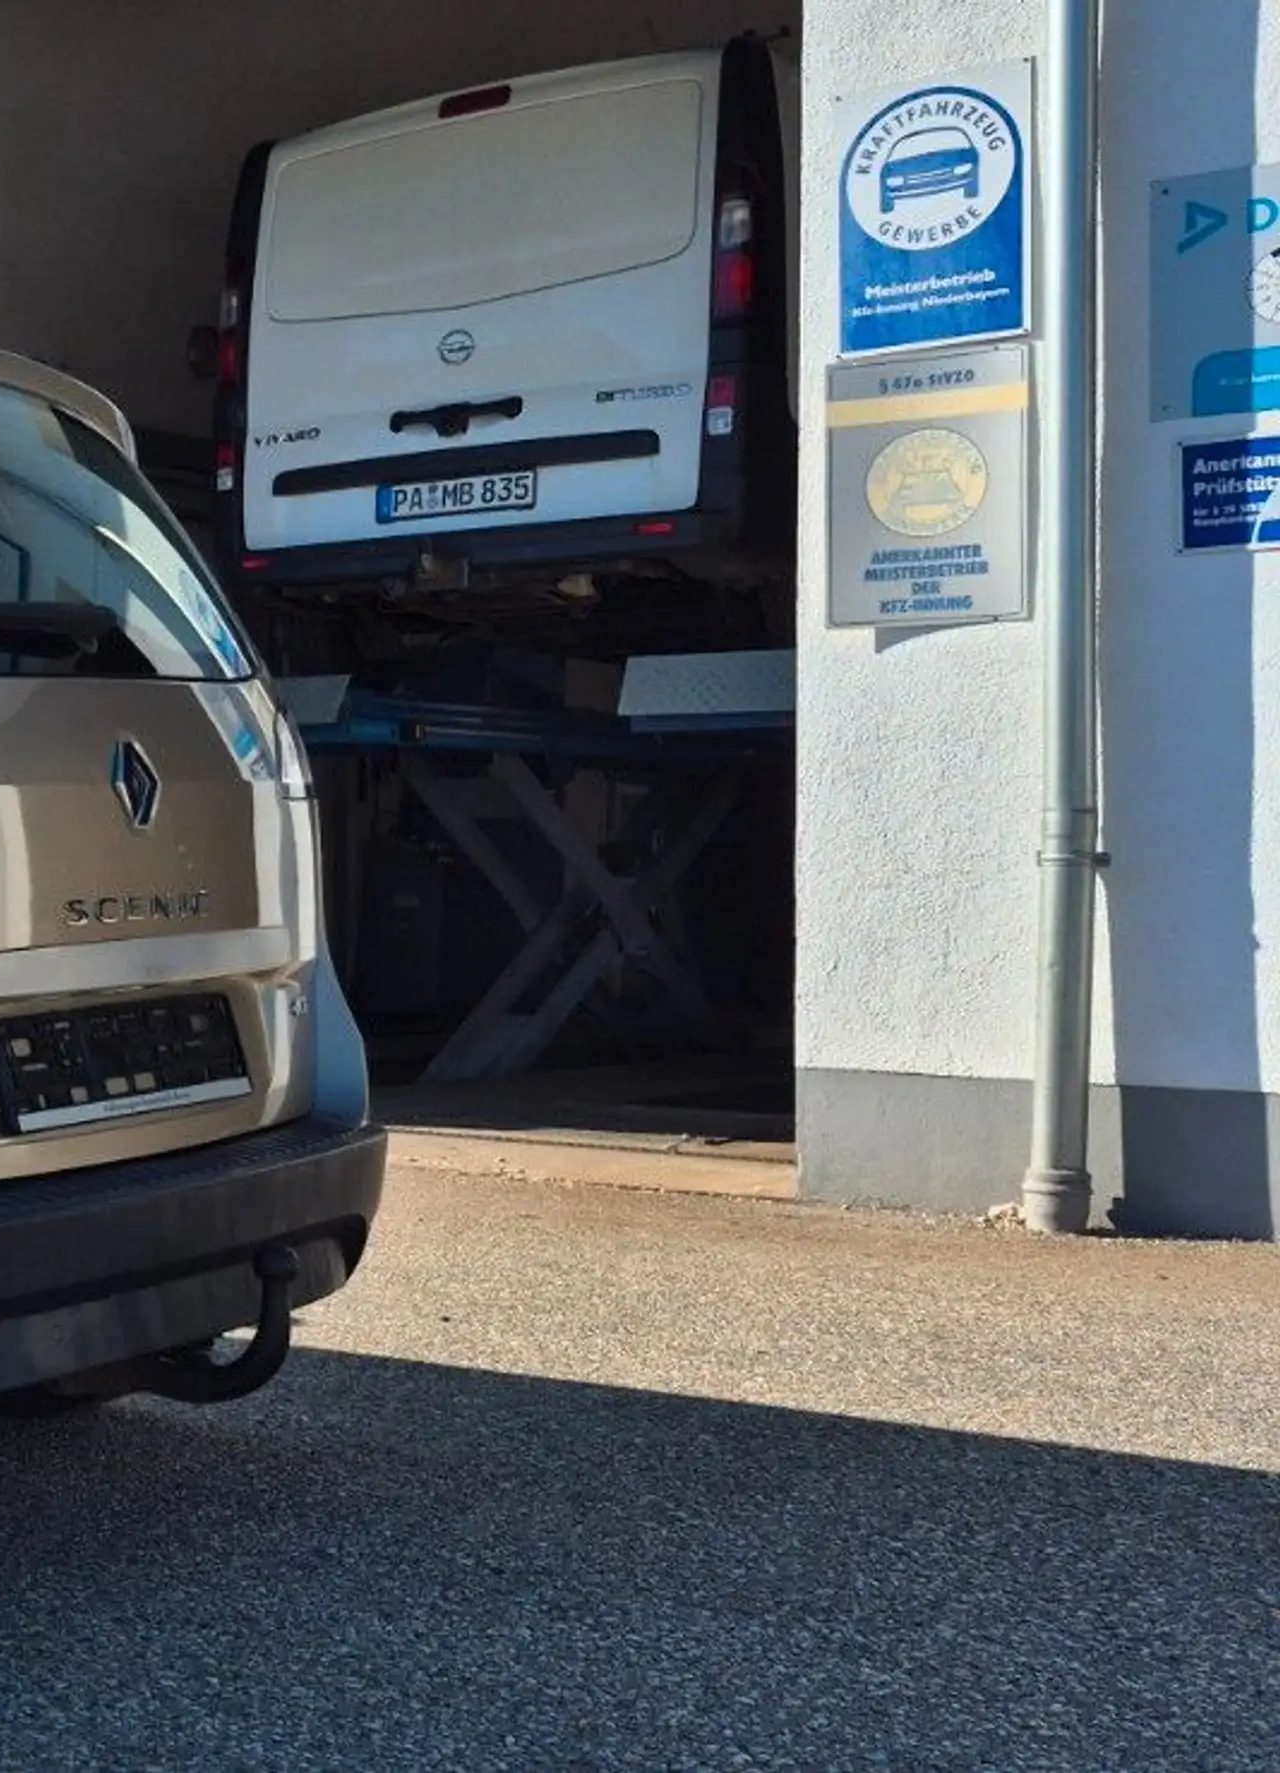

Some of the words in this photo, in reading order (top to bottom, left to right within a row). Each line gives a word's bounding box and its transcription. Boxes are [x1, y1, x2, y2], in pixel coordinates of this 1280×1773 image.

[856, 100, 1005, 174] KRAFTFAHRZEUG
[878, 205, 983, 244] GEWERBE
[865, 269, 995, 299] Meisterbetrieb
[393, 487, 424, 513] PA
[442, 482, 474, 507] MB
[481, 474, 530, 504] 835
[871, 544, 982, 565] ANERKANNTER
[864, 561, 989, 582] MEISTERBETRIEB
[911, 581, 941, 594] DER
[65, 889, 210, 926] SCENIC
